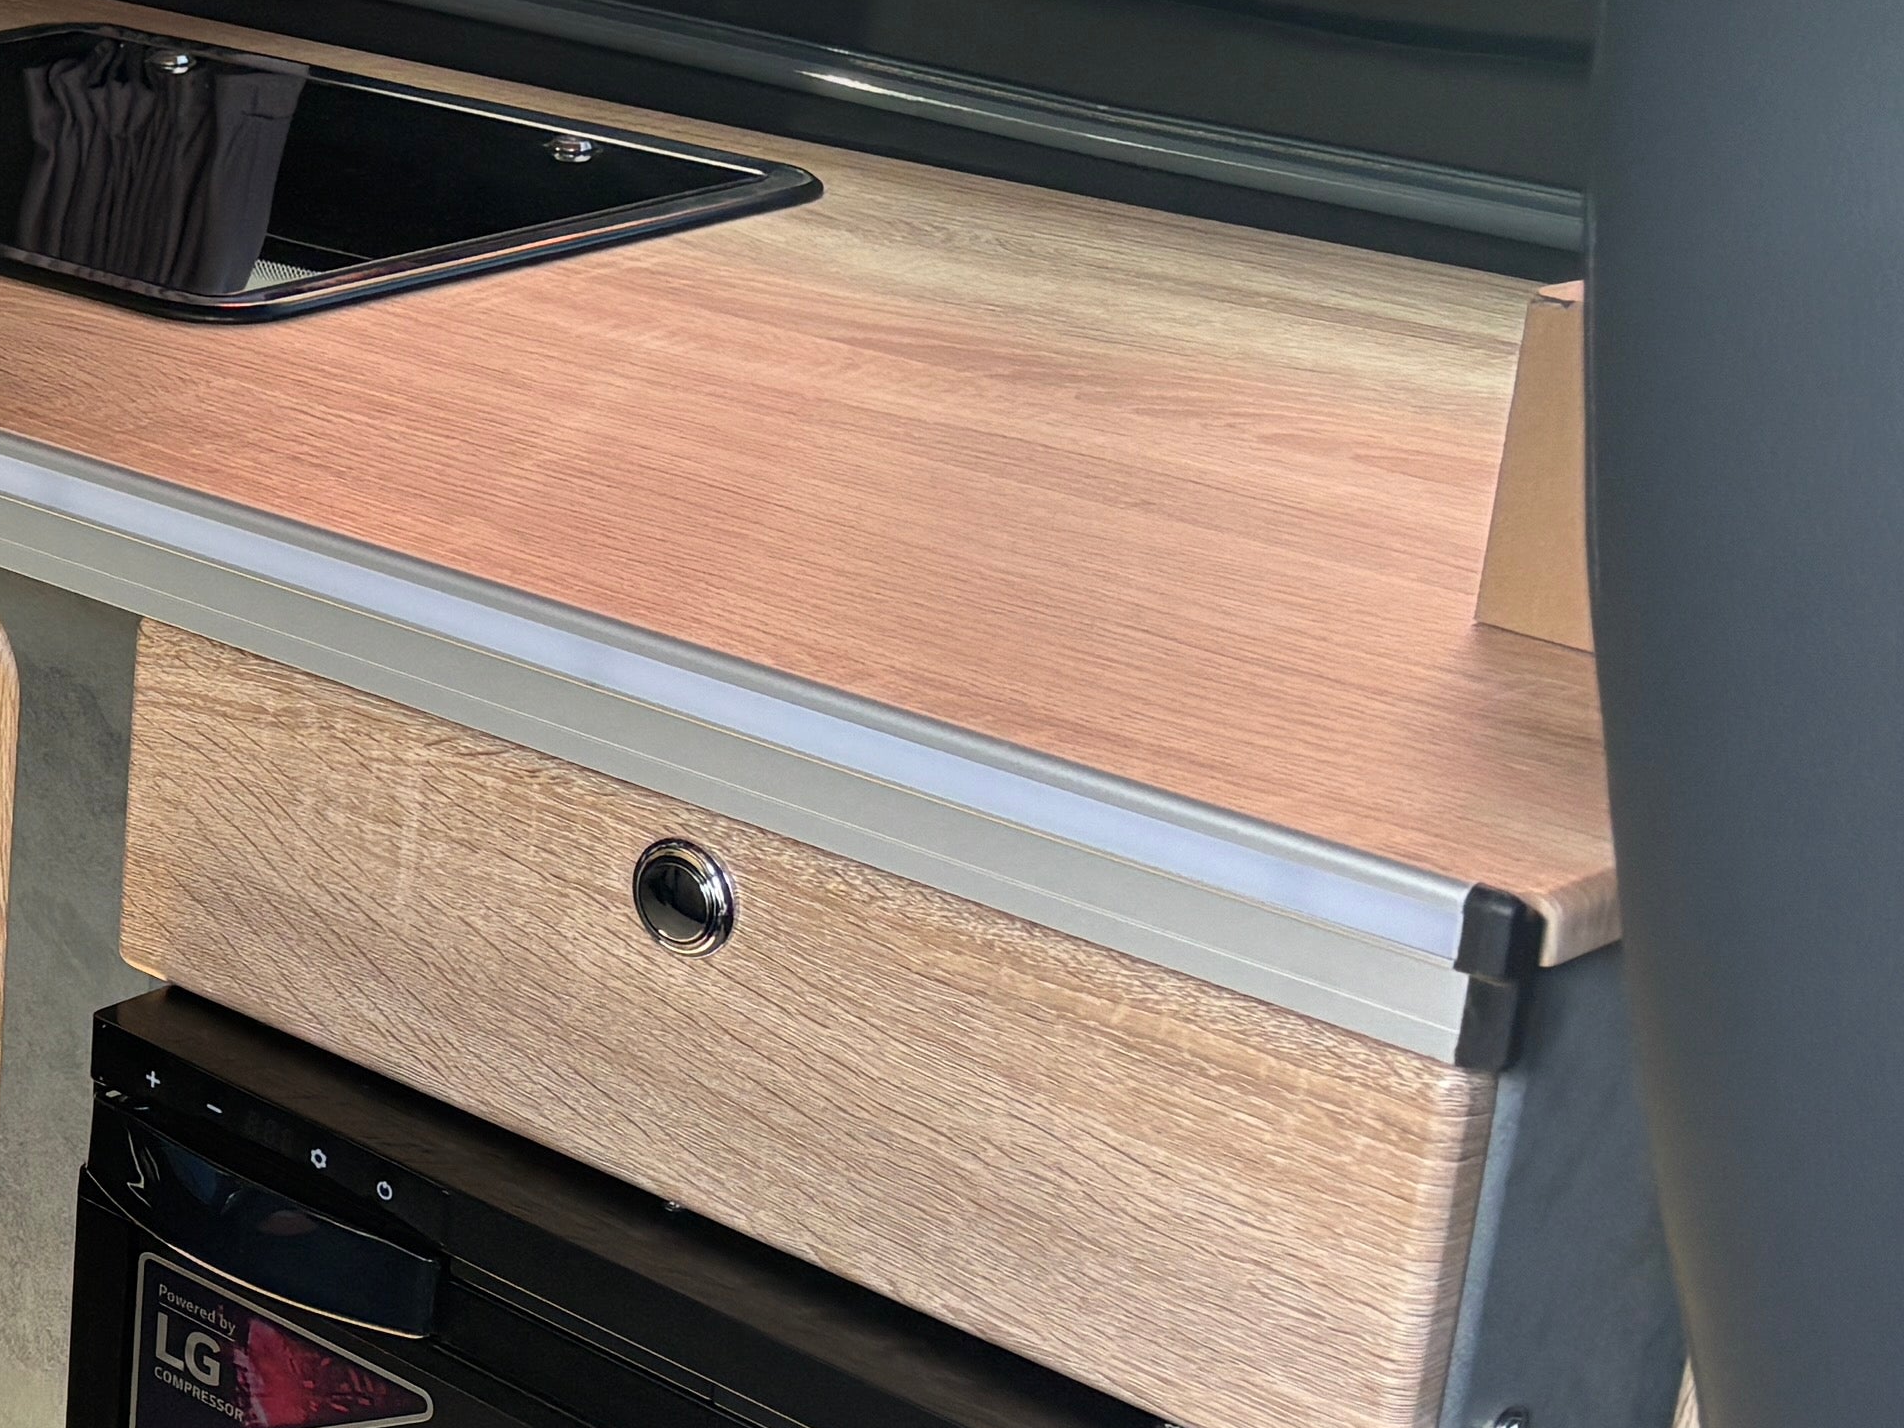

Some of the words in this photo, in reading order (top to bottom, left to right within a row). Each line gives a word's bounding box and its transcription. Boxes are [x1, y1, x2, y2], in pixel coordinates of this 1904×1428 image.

[158, 1283, 216, 1324] Powered
[219, 1313, 236, 1336] by
[155, 1311, 221, 1387] LG
[154, 1366, 245, 1422] COMPRESSOR
